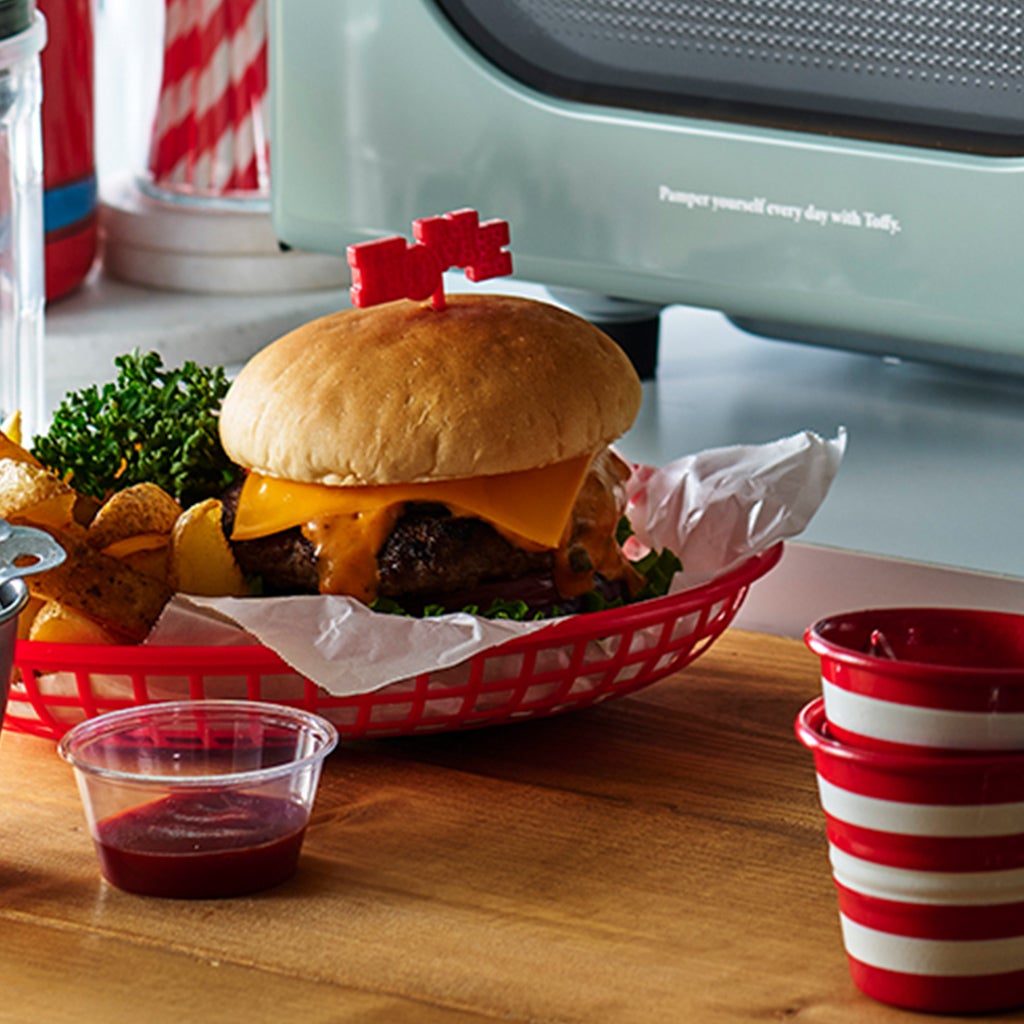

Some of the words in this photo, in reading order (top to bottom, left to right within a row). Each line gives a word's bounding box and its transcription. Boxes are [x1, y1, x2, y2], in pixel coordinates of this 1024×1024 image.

[659, 185, 710, 209] Pamper
[712, 196, 766, 214] yourself
[766, 202, 802, 223] every
[803, 204, 829, 226] day
[830, 209, 862, 227] with
